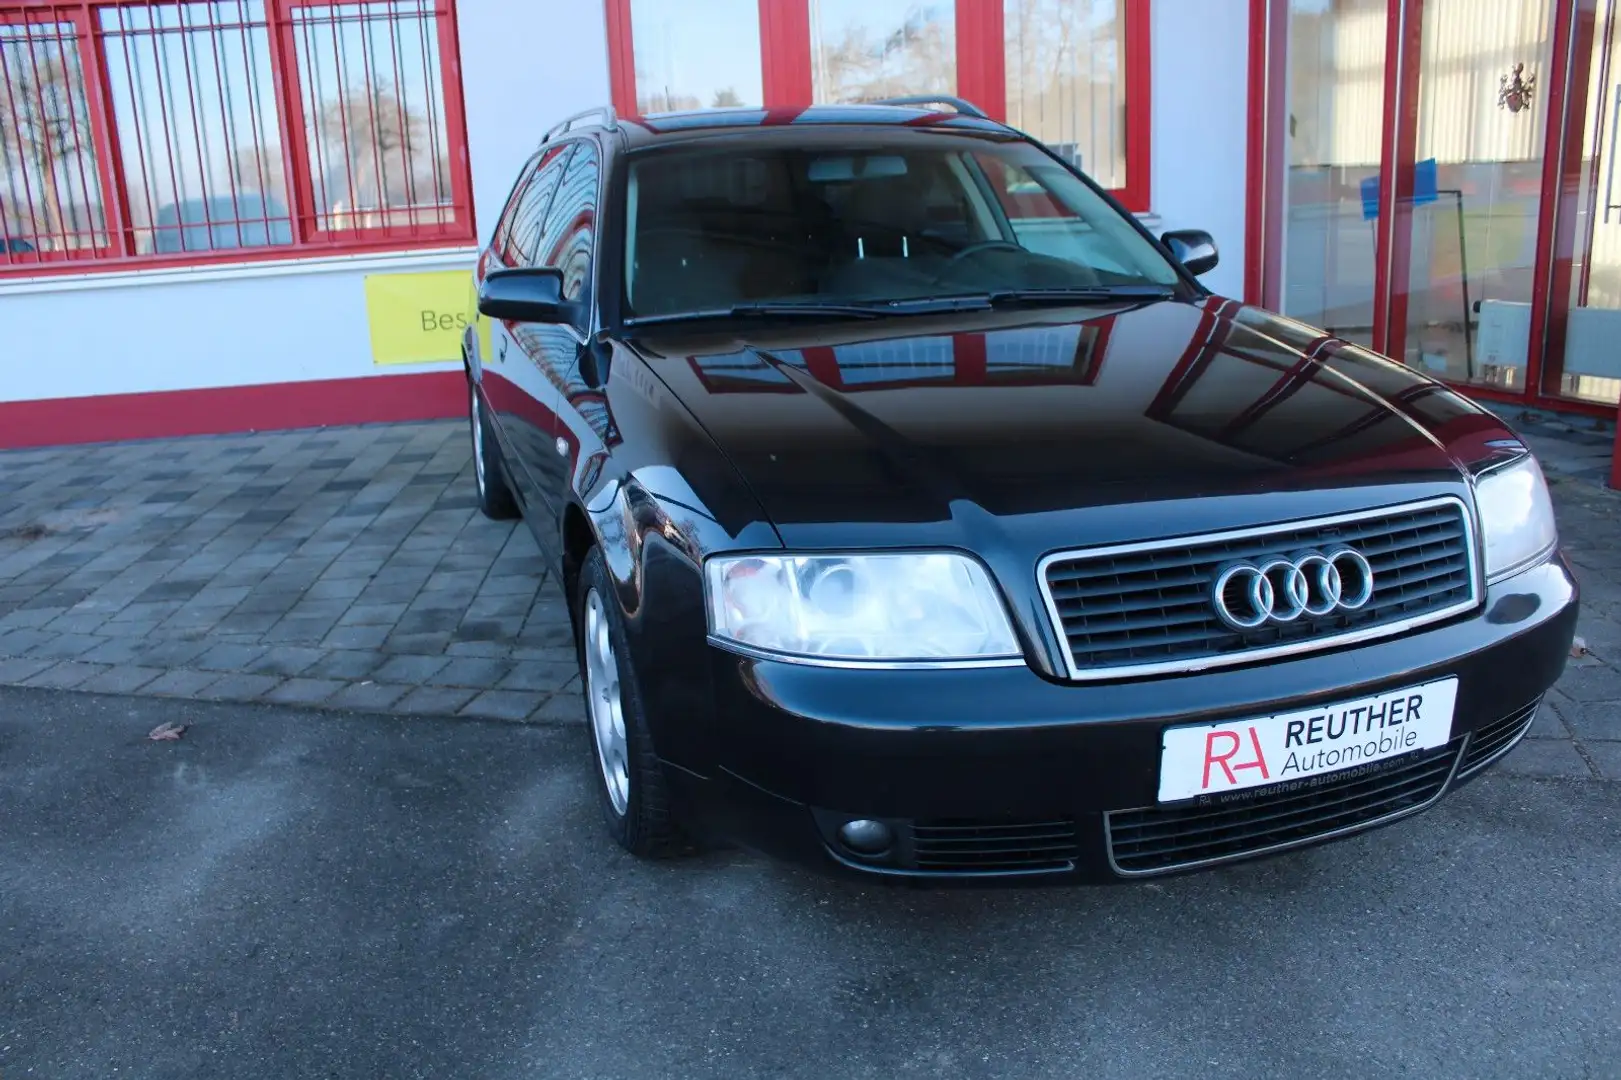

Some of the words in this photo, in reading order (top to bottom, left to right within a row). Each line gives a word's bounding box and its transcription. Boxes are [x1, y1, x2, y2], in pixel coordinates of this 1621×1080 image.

[421, 310, 468, 331] Bes
[1285, 694, 1423, 748] REUTHER
[1202, 727, 1270, 789] RA
[1280, 726, 1418, 775] Automobile
[1220, 757, 1405, 802] www.reuther-automobile.com
